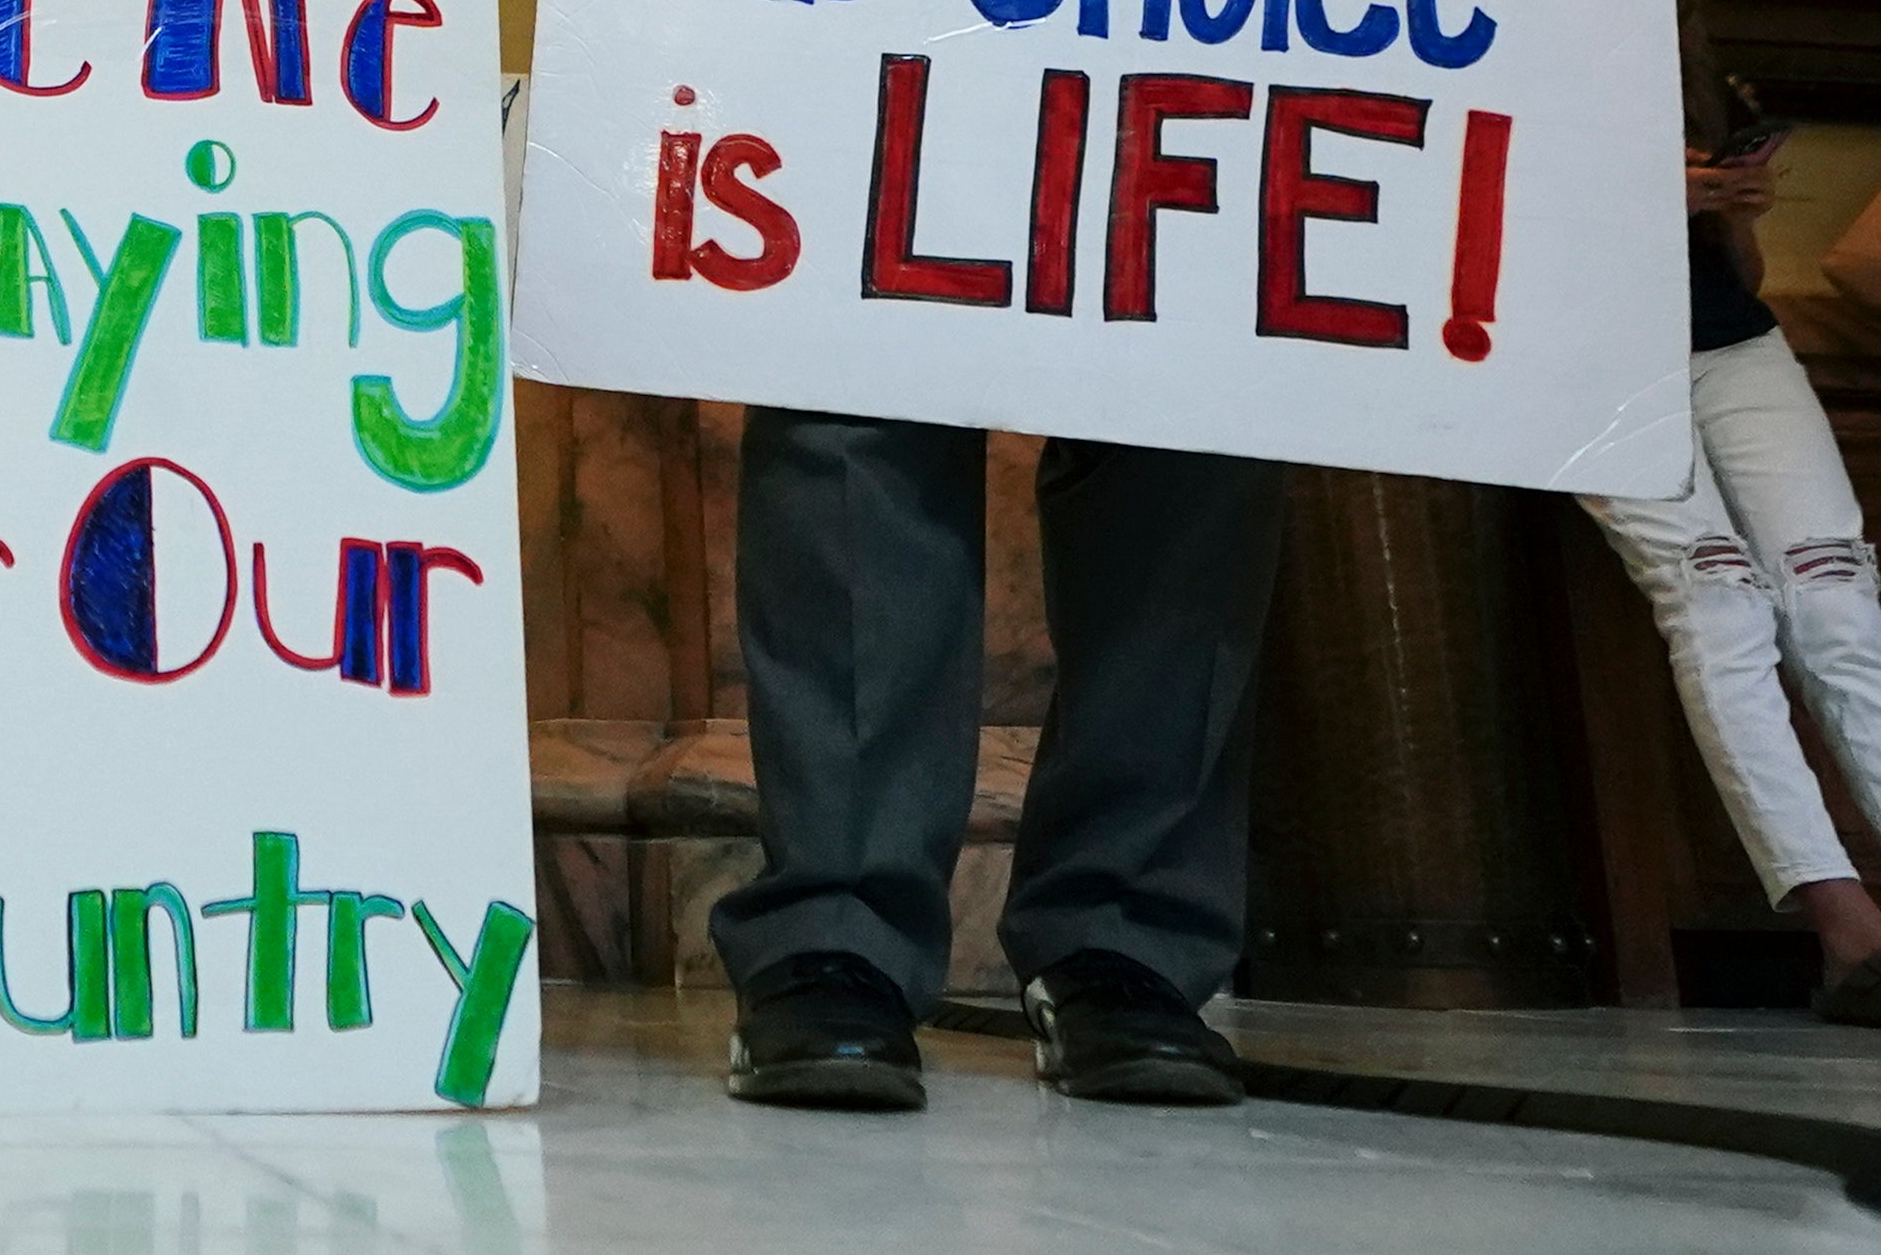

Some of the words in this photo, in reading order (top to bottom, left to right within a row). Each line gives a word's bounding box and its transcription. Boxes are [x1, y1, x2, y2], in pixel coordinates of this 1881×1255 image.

[651, 85, 801, 292] is
[861, 53, 1513, 363] LIFE!
[59, 456, 485, 698] Our
